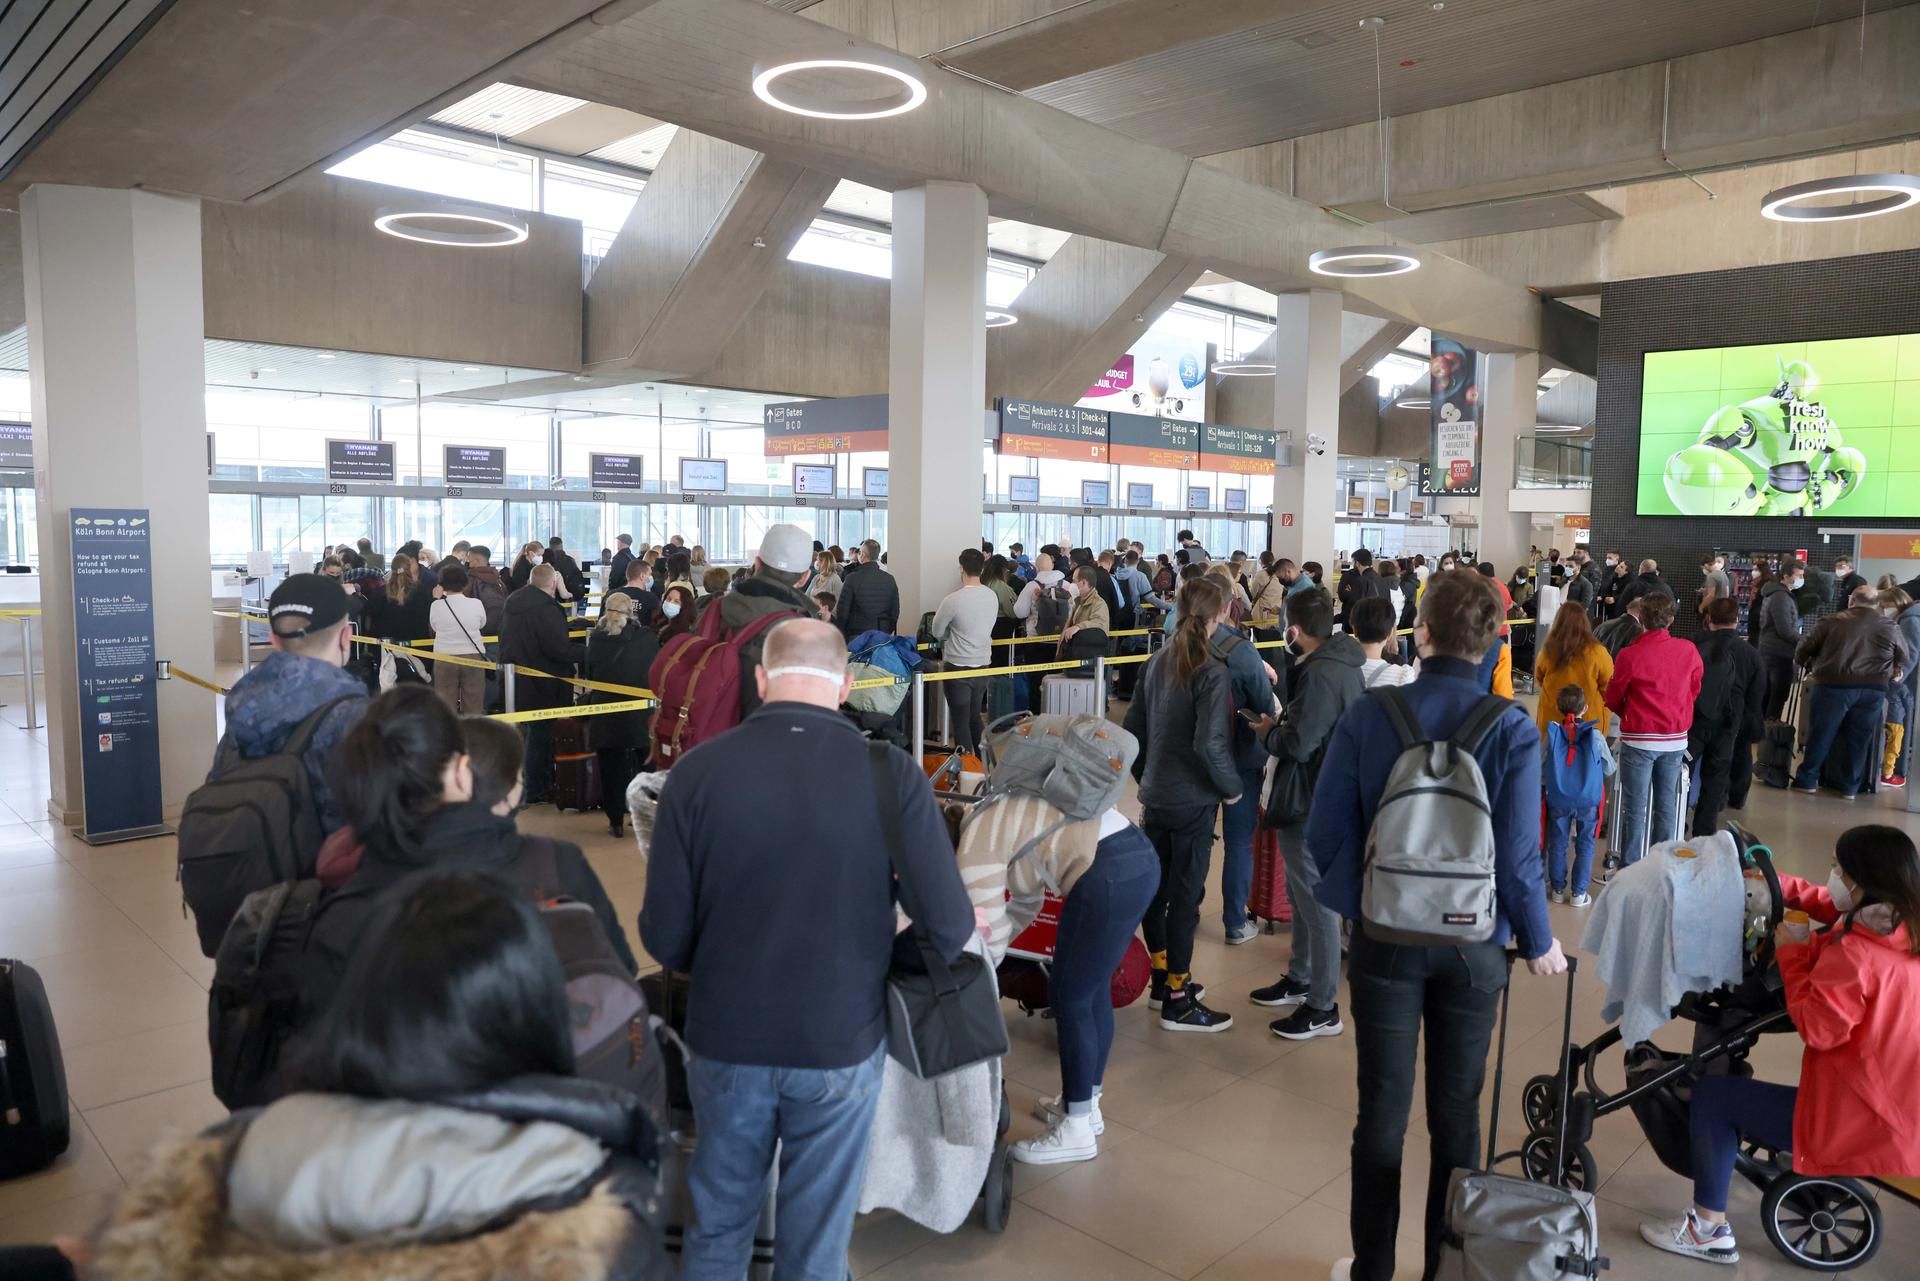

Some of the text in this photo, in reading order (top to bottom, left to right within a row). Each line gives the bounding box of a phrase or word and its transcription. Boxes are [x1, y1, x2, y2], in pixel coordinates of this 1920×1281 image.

[786, 408, 802, 417] Gates
[1032, 405, 1076, 419] Ankunft 2 & 3
[1789, 400, 1824, 418] fresh
[1081, 412, 1107, 423] Check-in
[791, 421, 795, 429] C
[1032, 420, 1076, 434] Arrivals 2 & 3
[1172, 423, 1187, 433] Gates
[1790, 416, 1830, 433] know
[1081, 426, 1106, 437] 301-440
[1177, 436, 1181, 445] C
[1796, 434, 1827, 450] how
[331, 485, 346, 493] 204
[117, 528, 146, 536] Airport
